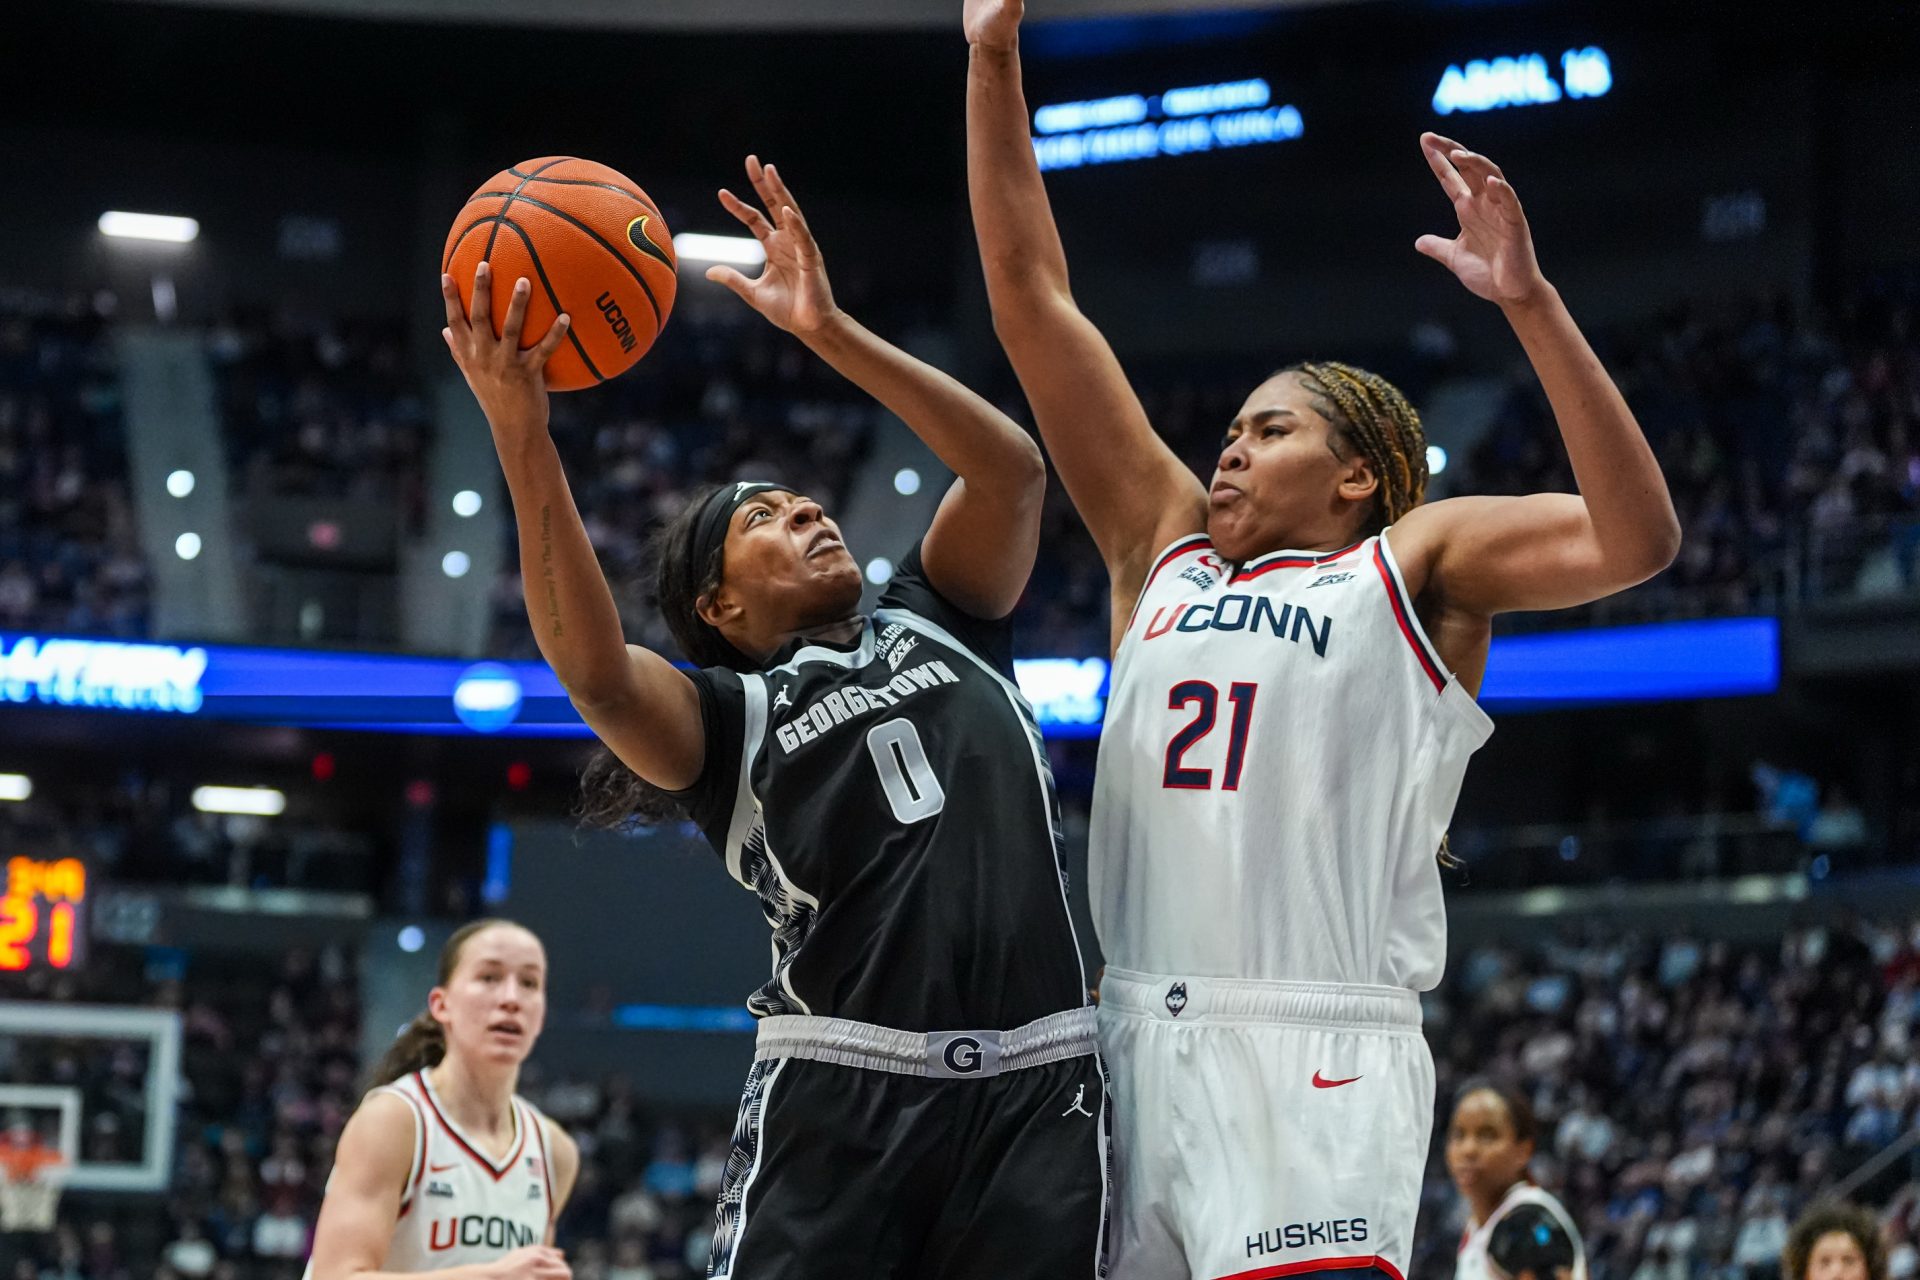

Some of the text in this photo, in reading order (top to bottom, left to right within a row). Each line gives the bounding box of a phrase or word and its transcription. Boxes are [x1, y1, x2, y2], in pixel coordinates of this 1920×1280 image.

[595, 291, 638, 354] UCONN
[874, 623, 899, 654] BE THE
[878, 624, 908, 660] CHANGE
[887, 637, 906, 665] BIG
[1143, 594, 1332, 658] UCONN
[775, 659, 960, 755] GEORGETOWN
[1162, 680, 1258, 791] 21
[867, 717, 946, 825] 0
[942, 1035, 985, 1075] G
[1246, 1218, 1368, 1258] HUSKIES
